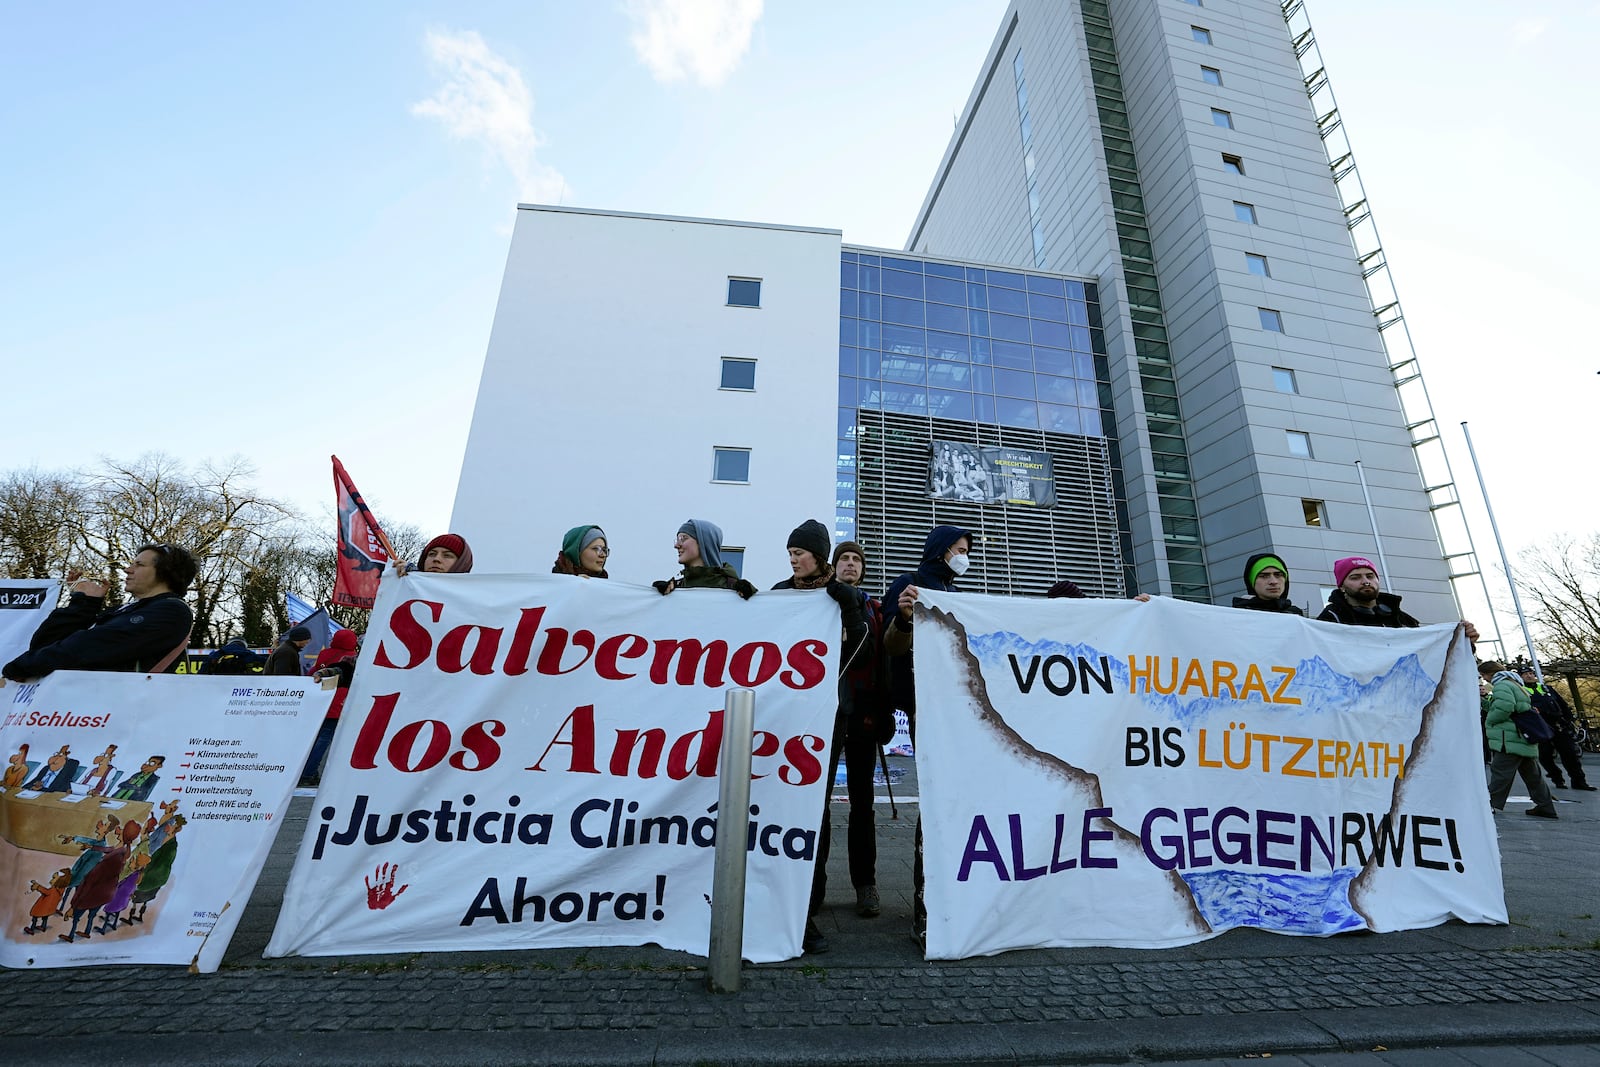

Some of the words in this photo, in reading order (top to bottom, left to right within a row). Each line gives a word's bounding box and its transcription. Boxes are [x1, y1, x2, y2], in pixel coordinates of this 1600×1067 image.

[12, 593, 40, 605] 2021
[373, 599, 828, 690] Salvemos
[1007, 653, 1114, 697] VON
[1128, 654, 1302, 705] HUARAZ
[231, 688, 305, 699] RWE-Tribunal.org
[26, 711, 111, 728] Schluss!
[350, 692, 506, 773] los
[189, 738, 202, 746] Wir
[203, 738, 230, 748] klagen
[1125, 726, 1186, 768] BIS
[1198, 721, 1405, 779] LÜTZERATH
[197, 750, 259, 760] Klimaverbrechen
[189, 774, 236, 784] Vertreibung
[185, 786, 253, 797] Umweltzerstörung
[195, 799, 217, 808] durch
[219, 800, 237, 808] RWE
[237, 800, 249, 808] und
[250, 800, 262, 809] die
[191, 812, 252, 822] Landesregierung
[252, 813, 273, 821] NRW
[311, 794, 554, 860] ¡Justicia
[570, 798, 817, 861] Climáica
[956, 807, 1118, 882] ALLE
[1140, 806, 1335, 872] GEGEN
[1340, 812, 1465, 874] RWE!
[459, 875, 667, 927] Ahora!
